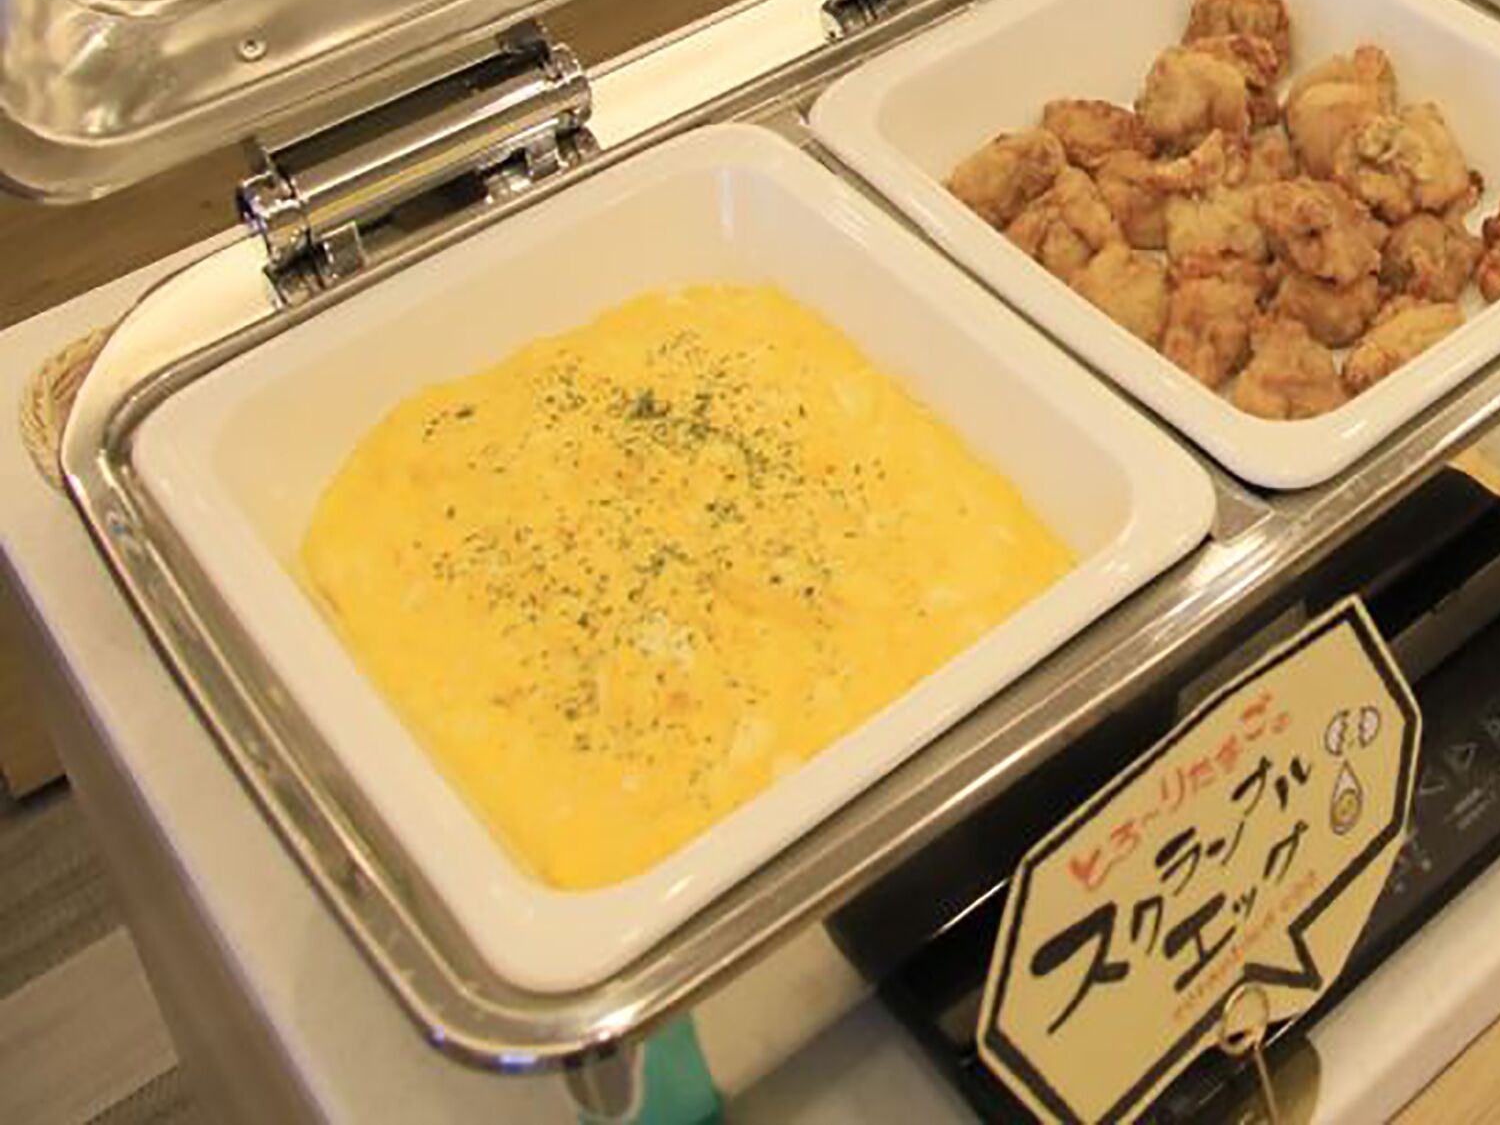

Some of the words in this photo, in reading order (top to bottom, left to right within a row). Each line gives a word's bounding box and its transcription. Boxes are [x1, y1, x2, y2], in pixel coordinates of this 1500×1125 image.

[1029, 755, 1312, 1035] スクランブル
[1163, 820, 1310, 994] エッグ
